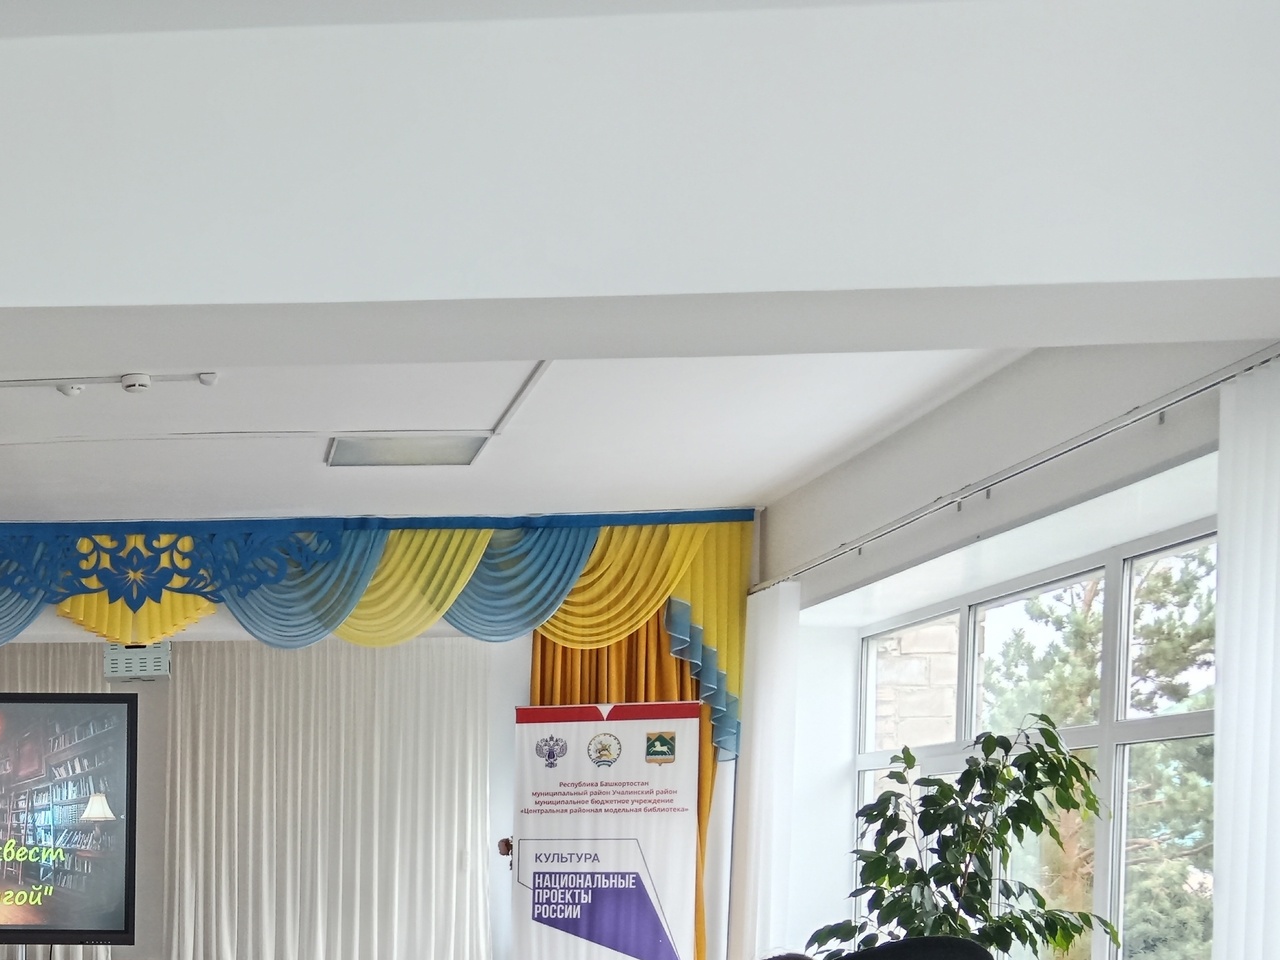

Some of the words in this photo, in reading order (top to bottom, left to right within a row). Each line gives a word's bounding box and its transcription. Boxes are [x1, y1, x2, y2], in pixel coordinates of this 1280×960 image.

[531, 790, 588, 798] муниципальный
[589, 789, 611, 797] район
[655, 788, 678, 796] район
[534, 852, 600, 863] КУЛЬТУРА
[534, 873, 637, 889] НАЦИОНАЛЬНЫЕ
[534, 889, 592, 903] ПРОЕКТЫ
[534, 904, 581, 918] РОССИИ
